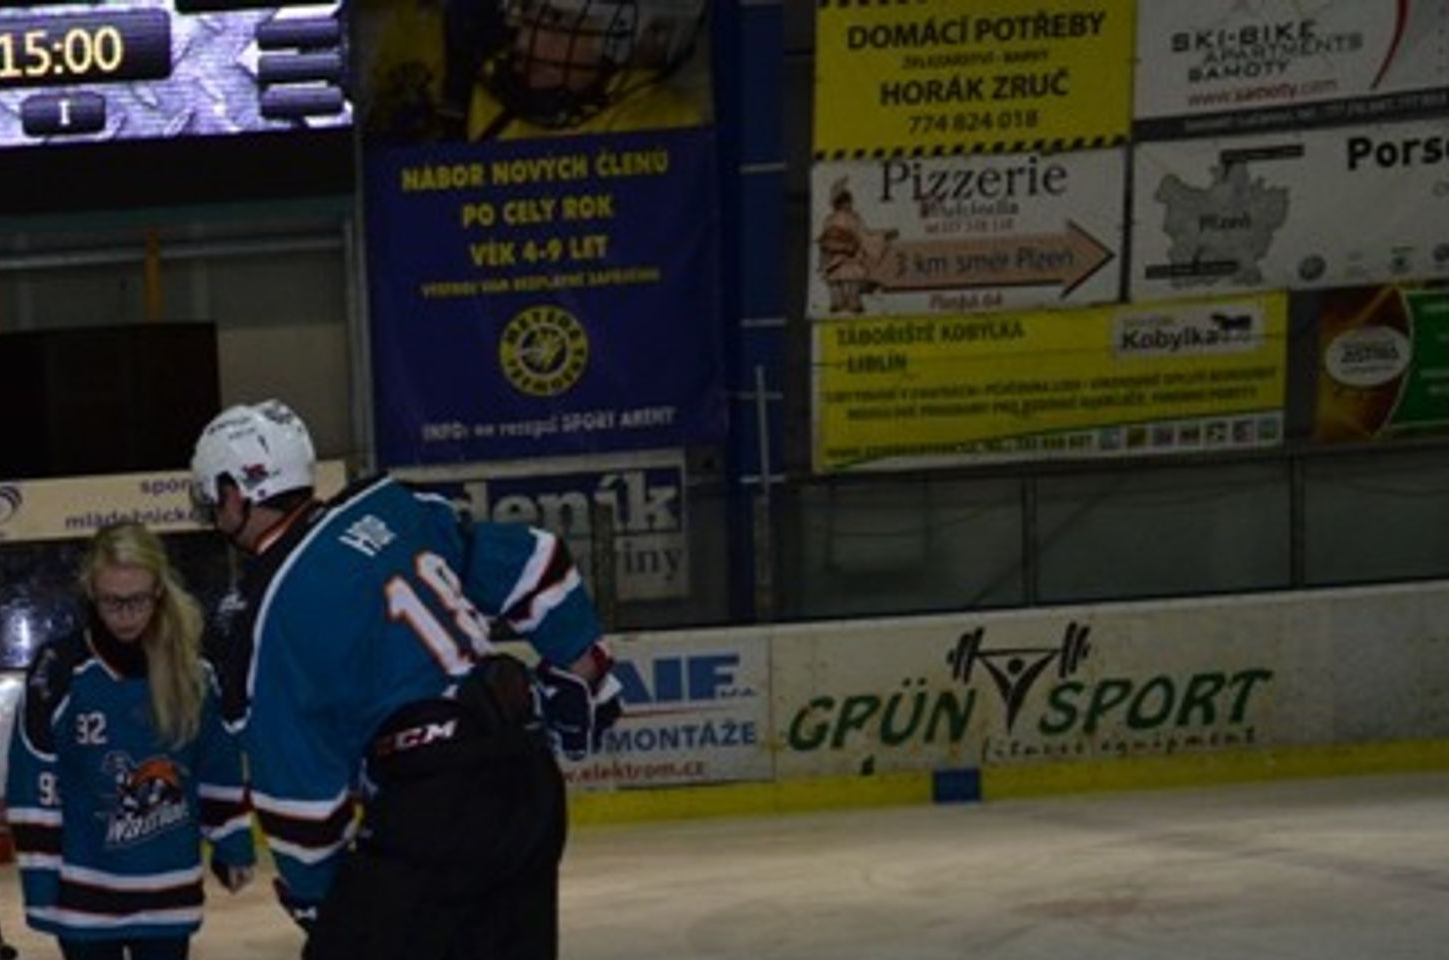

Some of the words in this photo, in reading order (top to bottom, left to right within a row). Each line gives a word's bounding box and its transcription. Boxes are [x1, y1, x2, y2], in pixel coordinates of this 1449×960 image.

[976, 9, 1105, 43] POTŘEBY
[1348, 136, 1449, 171] Pors
[881, 155, 1067, 202] Pizzerie
[462, 202, 495, 229] PO
[562, 194, 614, 220] ROK
[569, 234, 610, 260] LET
[1120, 326, 1218, 351] Kobylka
[1039, 669, 1274, 736] SPORT
[606, 717, 758, 754] MONTÁŽE
